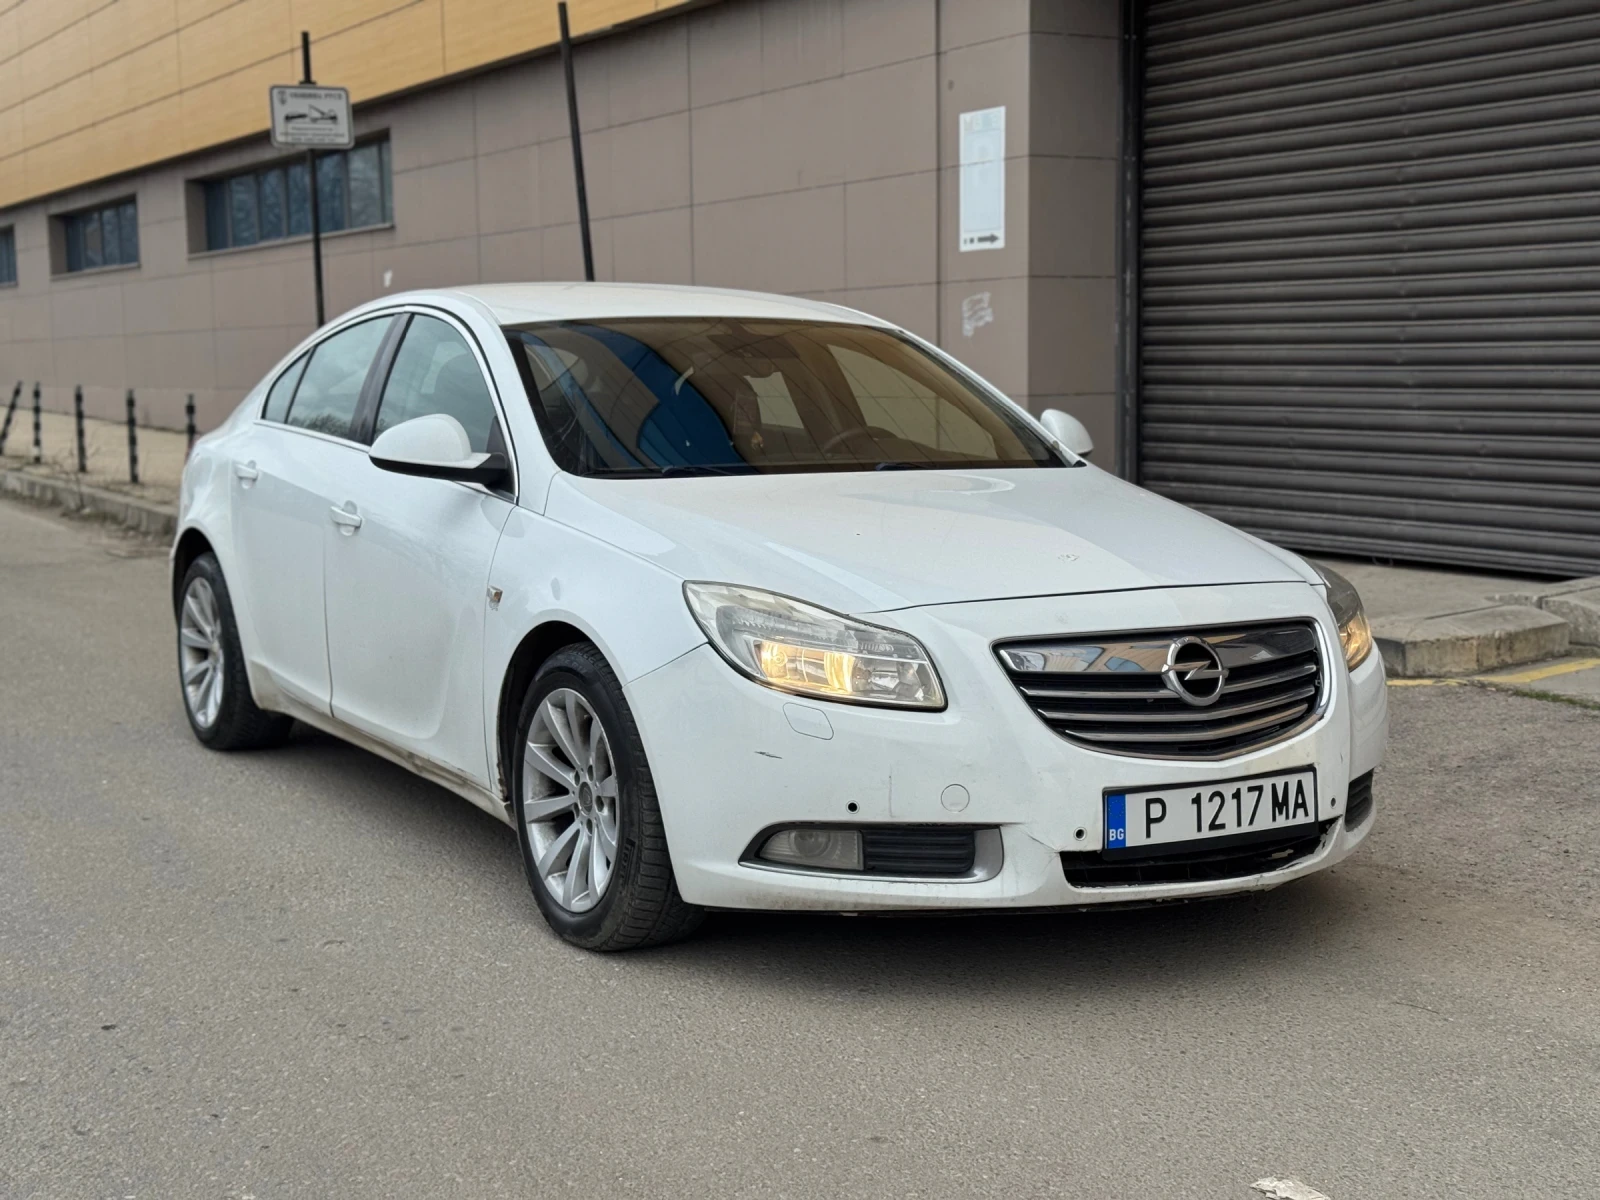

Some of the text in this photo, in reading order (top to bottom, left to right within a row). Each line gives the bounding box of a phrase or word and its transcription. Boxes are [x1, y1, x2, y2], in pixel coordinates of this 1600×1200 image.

[1145, 779, 1309, 839] P 1217 MA
[1109, 828, 1125, 841] BG
